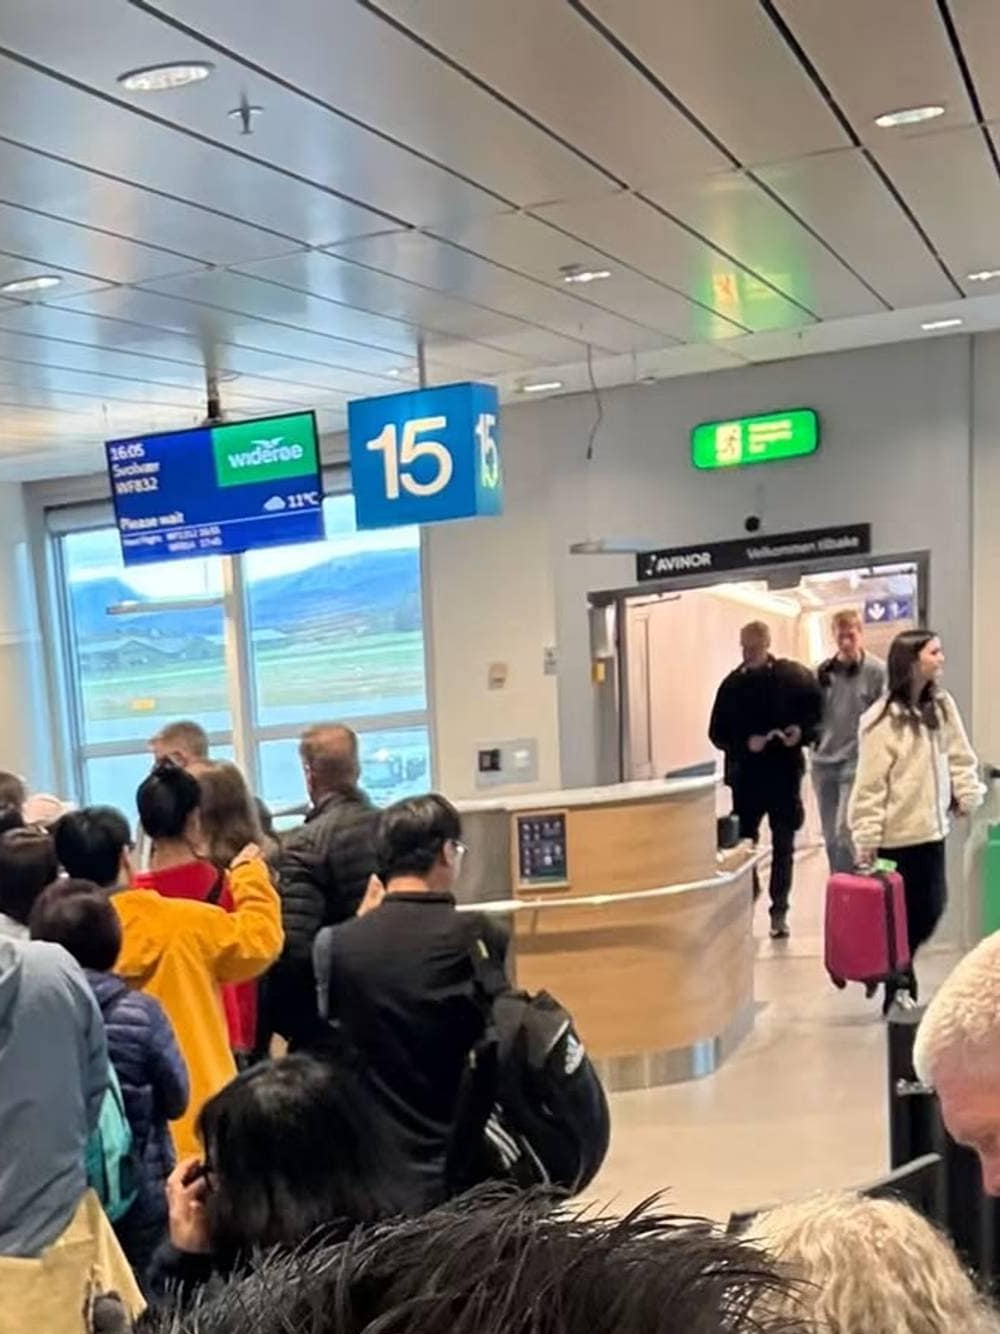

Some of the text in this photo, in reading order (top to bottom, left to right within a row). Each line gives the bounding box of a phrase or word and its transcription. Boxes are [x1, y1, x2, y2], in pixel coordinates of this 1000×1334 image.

[366, 415, 453, 499] 15
[475, 412, 498, 490] 15
[120, 511, 184, 531] Please wait
[656, 552, 712, 573] AVINOR
